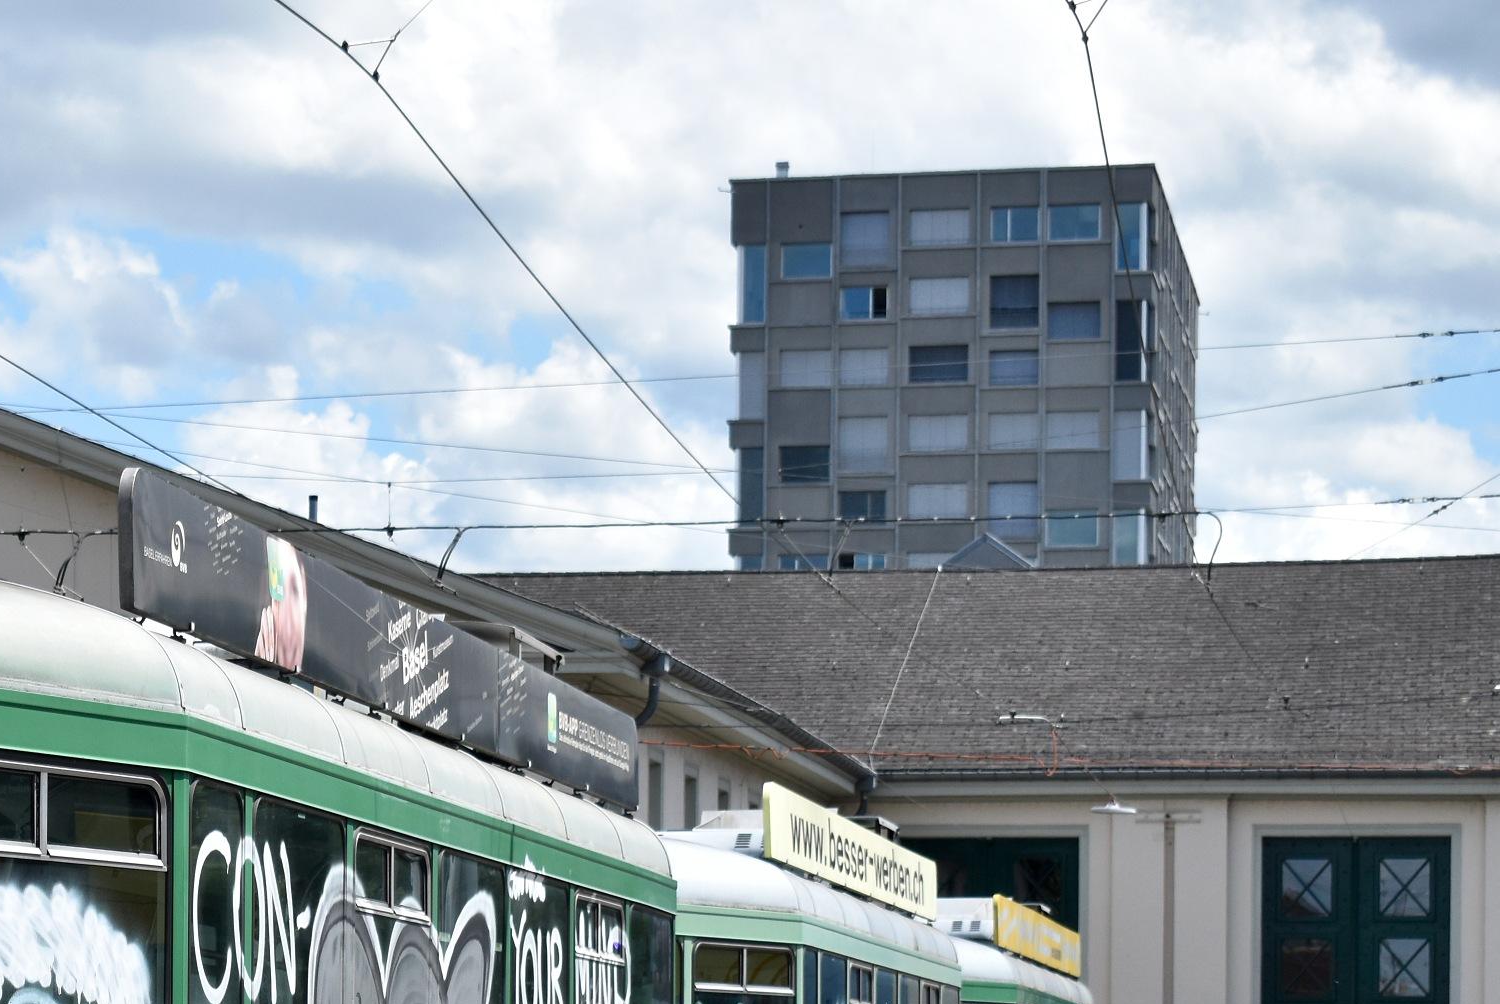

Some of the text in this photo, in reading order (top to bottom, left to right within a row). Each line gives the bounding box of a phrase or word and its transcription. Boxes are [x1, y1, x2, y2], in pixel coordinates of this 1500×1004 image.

[179, 561, 188, 574] BVB
[387, 611, 412, 643] Kaserne
[402, 630, 429, 685] Basel
[409, 668, 450, 720] Aeschenplatz
[789, 813, 925, 907] www.besser-werben.ch
